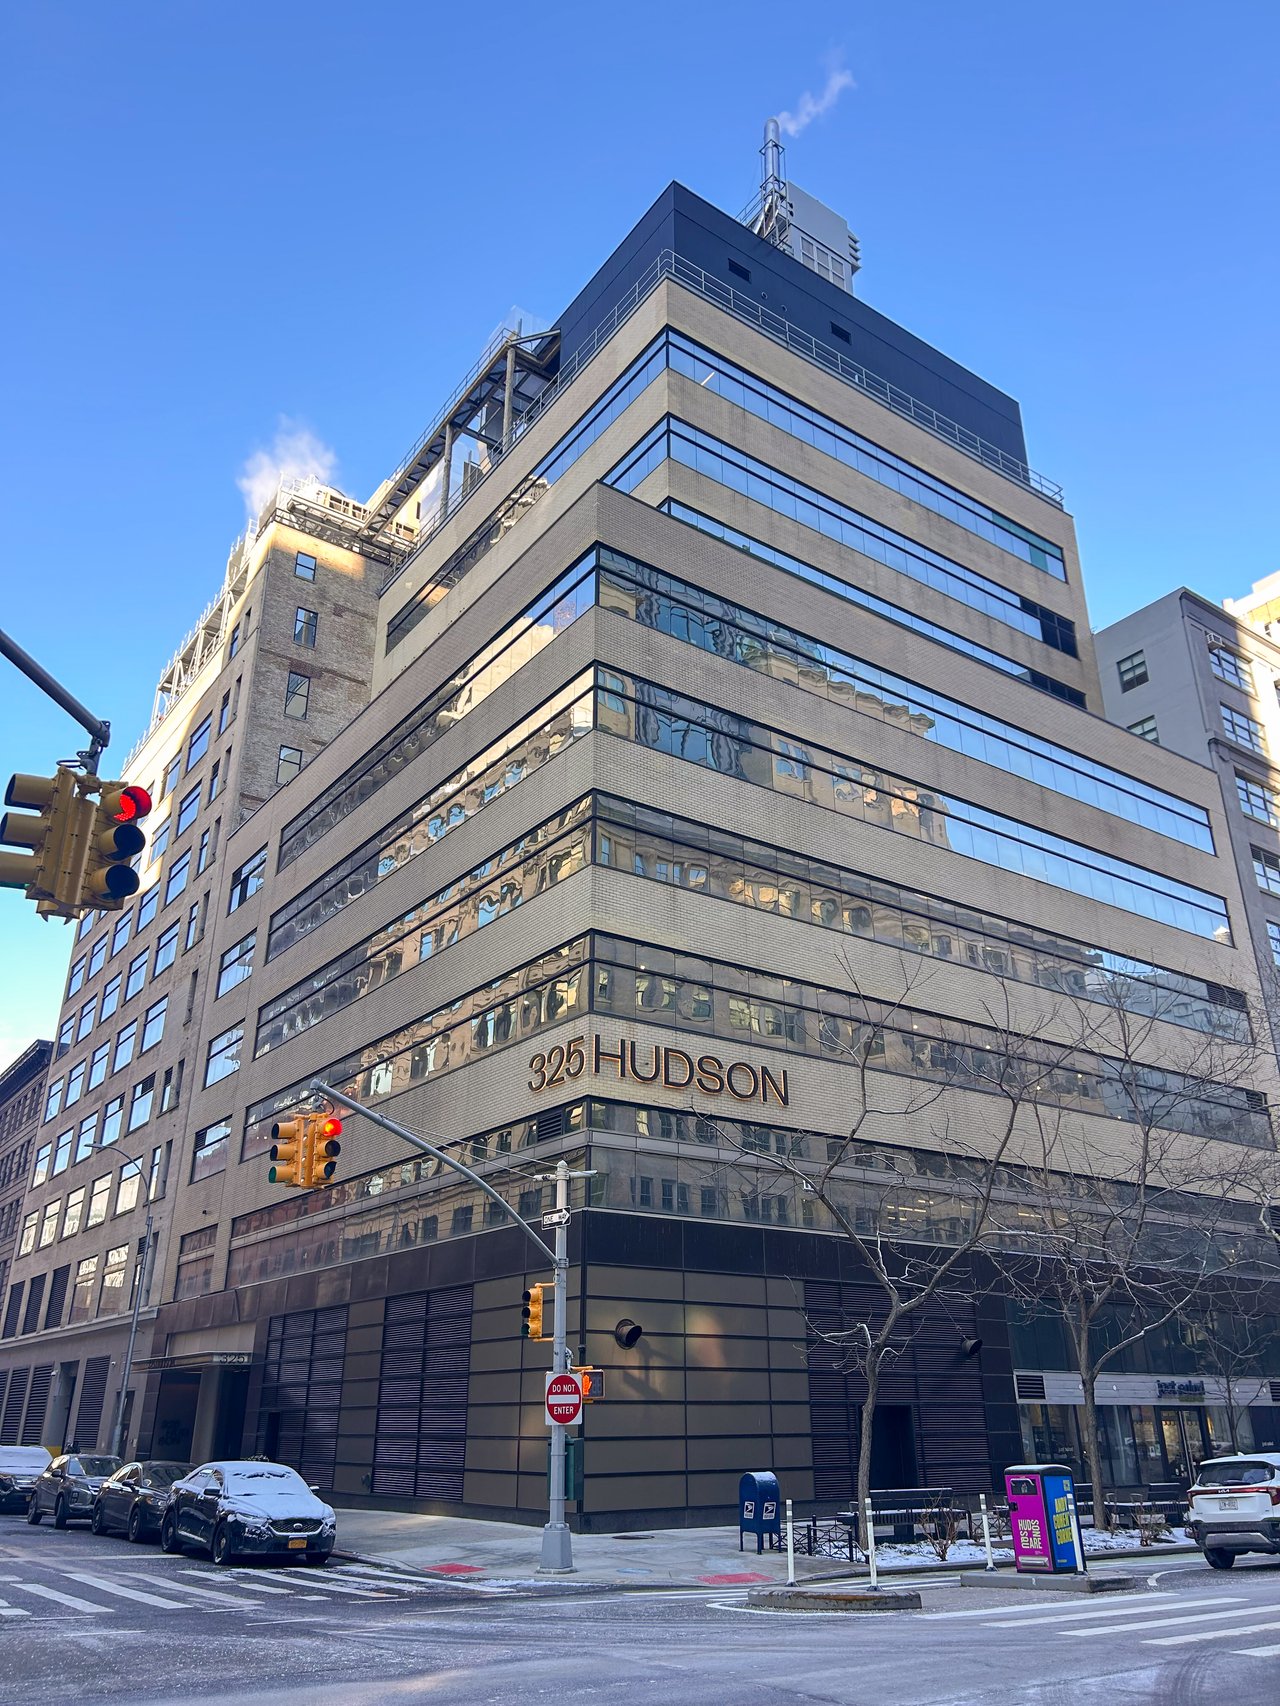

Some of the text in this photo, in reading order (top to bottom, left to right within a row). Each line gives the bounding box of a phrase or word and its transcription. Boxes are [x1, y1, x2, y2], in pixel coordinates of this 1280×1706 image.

[528, 1034, 790, 1106] 325 HUDSON
[544, 1216, 554, 1224] ONE
[220, 1352, 245, 1364] 325
[552, 1384, 575, 1392] DO NOT
[553, 1406, 574, 1415] ENTER
